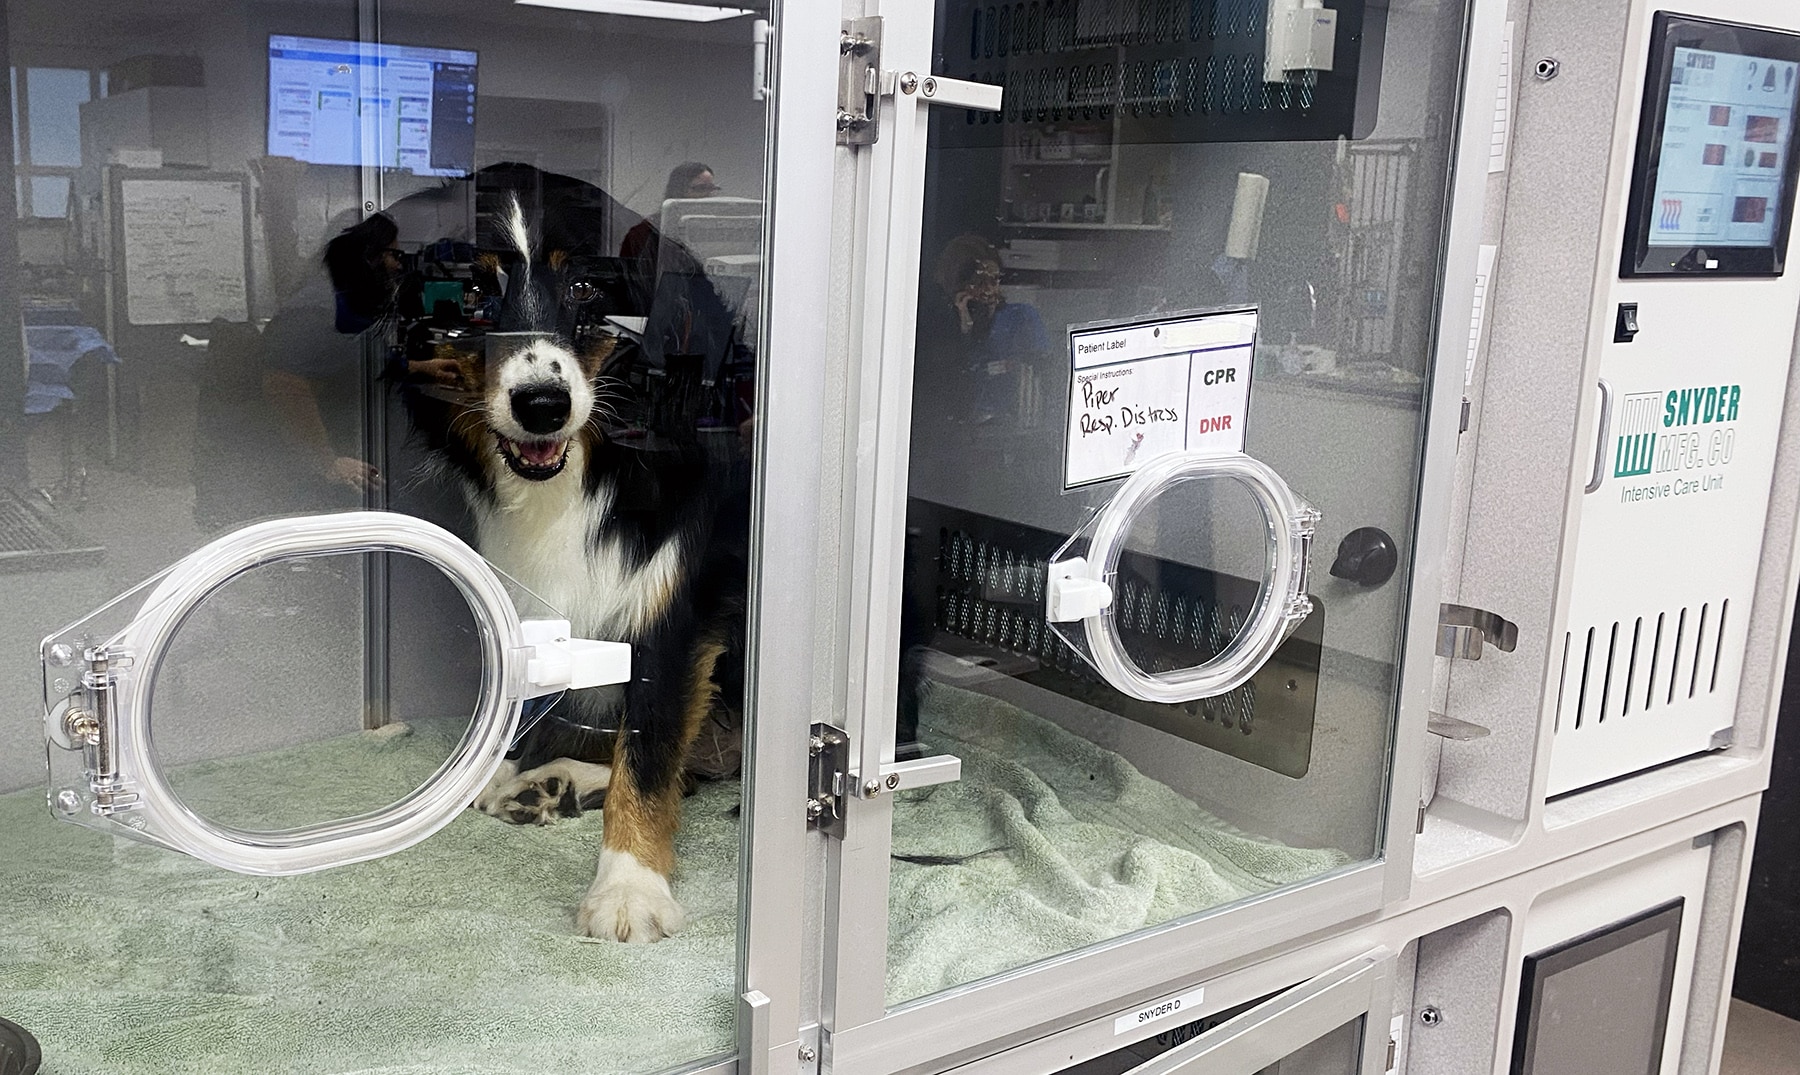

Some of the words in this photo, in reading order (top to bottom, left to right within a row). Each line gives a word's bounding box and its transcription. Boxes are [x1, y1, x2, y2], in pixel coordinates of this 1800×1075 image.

[1078, 342, 1105, 354] Patient
[1107, 339, 1127, 350] Label
[1077, 372, 1098, 384] Special
[1099, 368, 1134, 380] Instructions:
[1204, 368, 1236, 386] CPR
[1082, 381, 1119, 409] Piper
[1663, 385, 1741, 428] SNYDER
[1080, 413, 1118, 438] Resp.
[1120, 404, 1178, 428] Distress
[1200, 415, 1232, 434] DNR
[1708, 428, 1735, 466] CO
[1621, 482, 1671, 504] Intensive
[1674, 478, 1699, 496] Care
[1702, 474, 1723, 492] Unit
[1138, 1002, 1173, 1022] SNYDER
[1174, 1000, 1181, 1010] D
